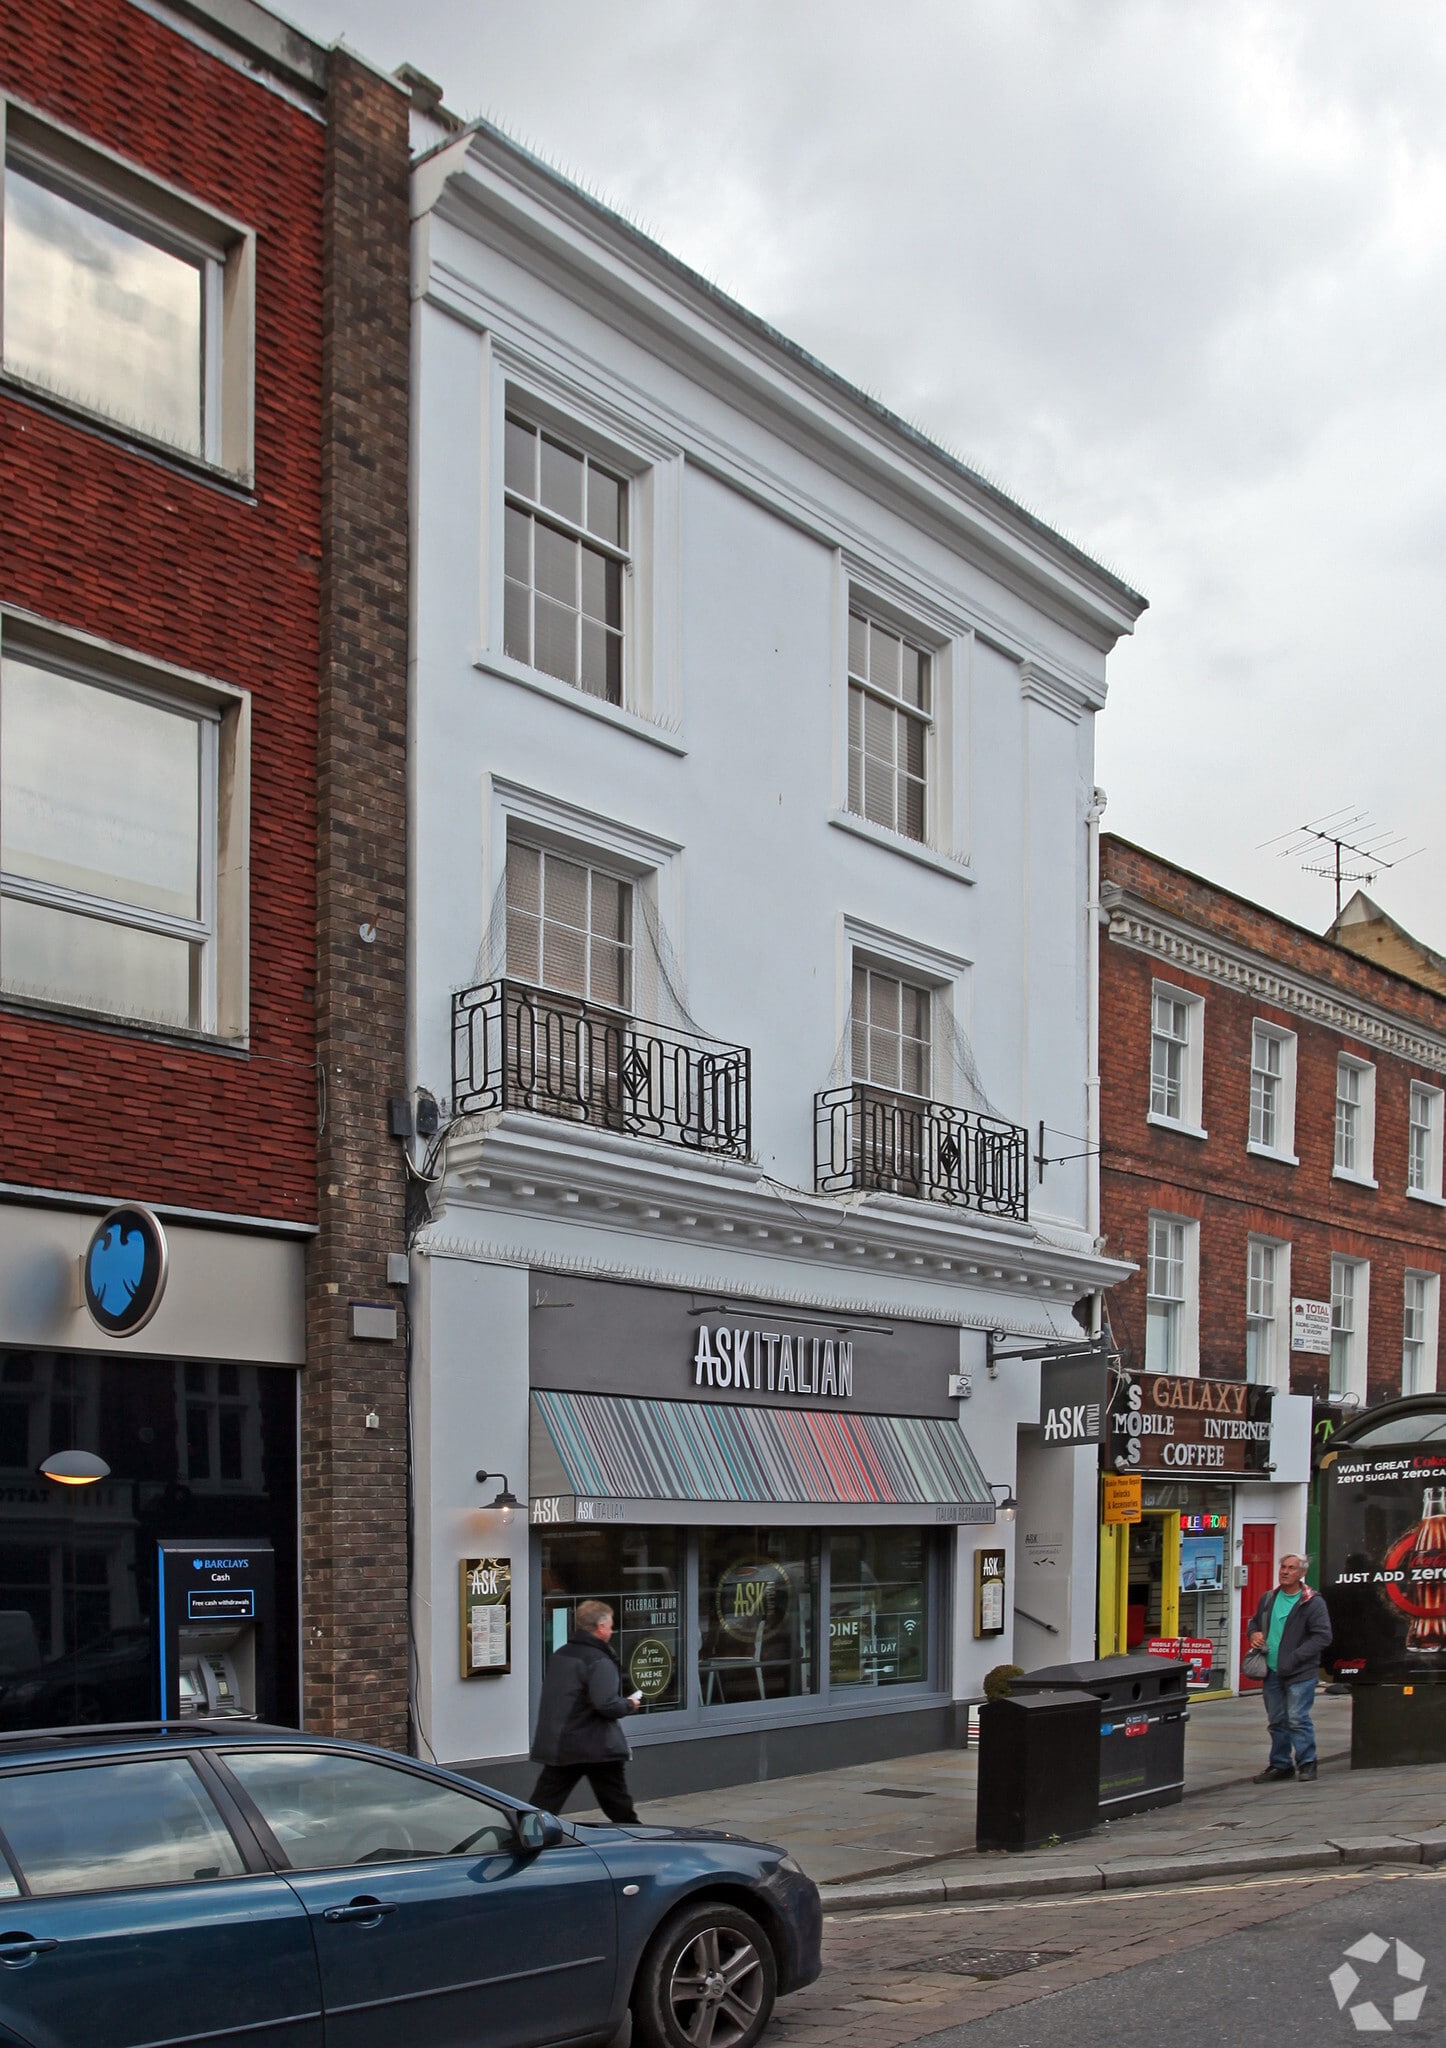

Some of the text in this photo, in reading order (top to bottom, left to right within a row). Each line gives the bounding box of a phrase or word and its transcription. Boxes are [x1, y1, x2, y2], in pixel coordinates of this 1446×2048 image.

[1306, 1303, 1329, 1316] TOTAL
[694, 1325, 853, 1397] ASK ITALIAN
[1153, 1377, 1247, 1414] GALAXY
[1044, 1405, 1086, 1441] ASK
[1112, 1413, 1175, 1436] MOBILE
[1163, 1443, 1225, 1467] COFFEE
[1337, 1463, 1372, 1474] WANT
[1374, 1460, 1411, 1471] GREAT
[1337, 1474, 1364, 1484] zero
[1365, 1472, 1398, 1482] SUGAR
[1402, 1469, 1431, 1479] zero
[533, 1498, 560, 1523] ASK
[578, 1501, 594, 1520] ASK
[204, 1559, 249, 1569] BARCLAYS
[983, 1557, 999, 1576] ASK
[211, 1573, 230, 1582] Cash
[471, 1569, 498, 1595] ASK
[1335, 1572, 1370, 1584] JUST
[1373, 1571, 1404, 1582] ADD
[625, 1598, 677, 1611] CELEBRATE YOUR
[734, 1582, 765, 1617] ASK
[650, 1612, 677, 1624] WITH US
[830, 1621, 858, 1637] DINE
[642, 1646, 659, 1657] if you
[863, 1642, 897, 1654] ALL DAY
[652, 1656, 664, 1665] stay
[636, 1670, 662, 1679] TAKE ME
[641, 1679, 661, 1688] AWAY
